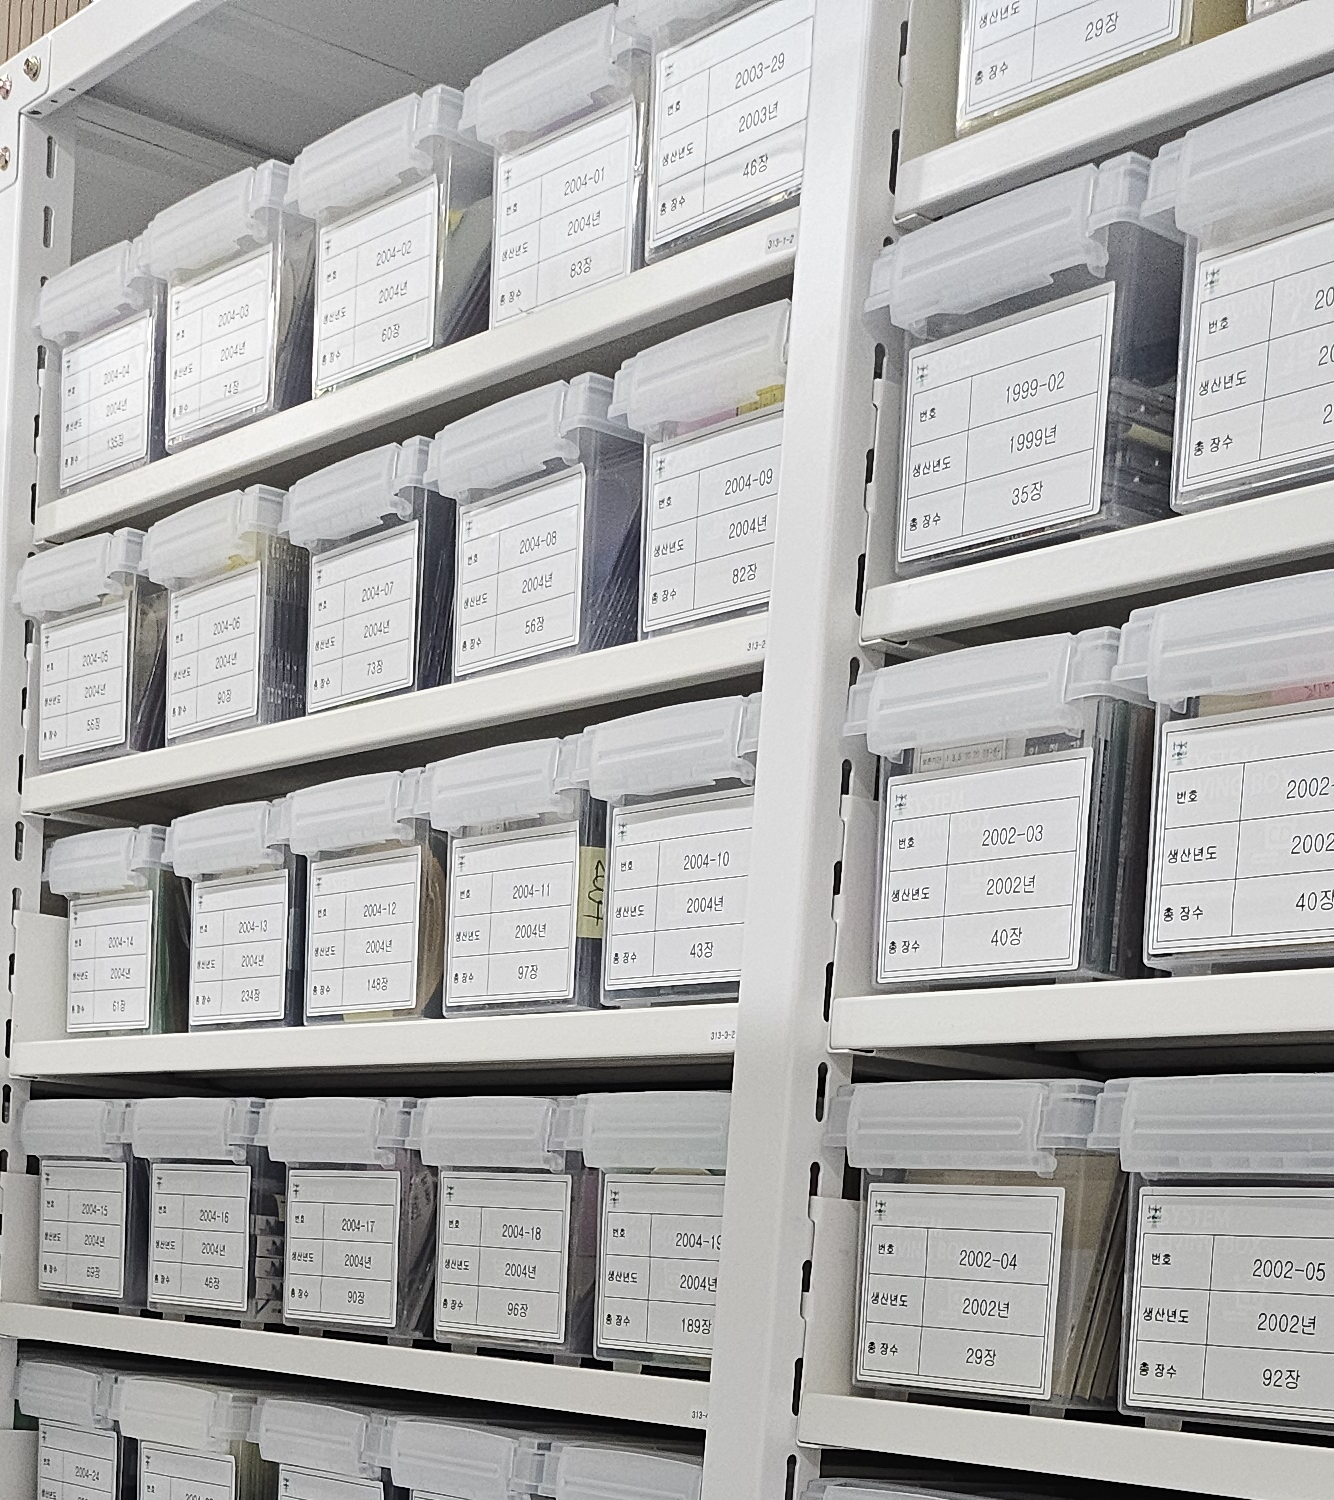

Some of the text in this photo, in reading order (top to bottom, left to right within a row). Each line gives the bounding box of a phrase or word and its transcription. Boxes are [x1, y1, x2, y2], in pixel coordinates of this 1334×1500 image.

[978, 2, 1020, 29] 생산년도
[988, 61, 1009, 80] 장수
[1085, 12, 1119, 42] 29장
[735, 52, 785, 90] 2003-29
[739, 100, 779, 133] 2003년
[742, 153, 769, 178] 46장
[564, 166, 605, 196] 2004-01
[570, 256, 592, 279] 83장
[1006, 371, 1065, 404] 1999-02
[1010, 424, 1057, 453] 1999년
[724, 468, 773, 496] 2004-09
[1012, 480, 1043, 506] 35장
[519, 530, 557, 555] 2004-08
[732, 563, 758, 585] 82장
[525, 616, 545, 635] 56장
[981, 824, 1043, 847] 2002-03
[683, 851, 730, 870] 2004-10
[512, 883, 550, 900] 2004-11
[363, 901, 397, 918] 2004-12
[686, 895, 724, 914] 2004년
[990, 927, 1022, 947] 40장
[689, 941, 714, 958] 43장
[518, 964, 538, 980] 97장
[341, 1218, 375, 1233] 2004-17
[502, 1223, 541, 1241] 2004-18
[959, 1250, 1017, 1270] 2002-04
[1253, 1259, 1326, 1282] 2002-05
[507, 1302, 528, 1317] 96장
[682, 1318, 712, 1335] 189장
[1258, 1312, 1316, 1336] 2002년
[966, 1348, 996, 1367] 29장
[1262, 1369, 1300, 1390] 92장
